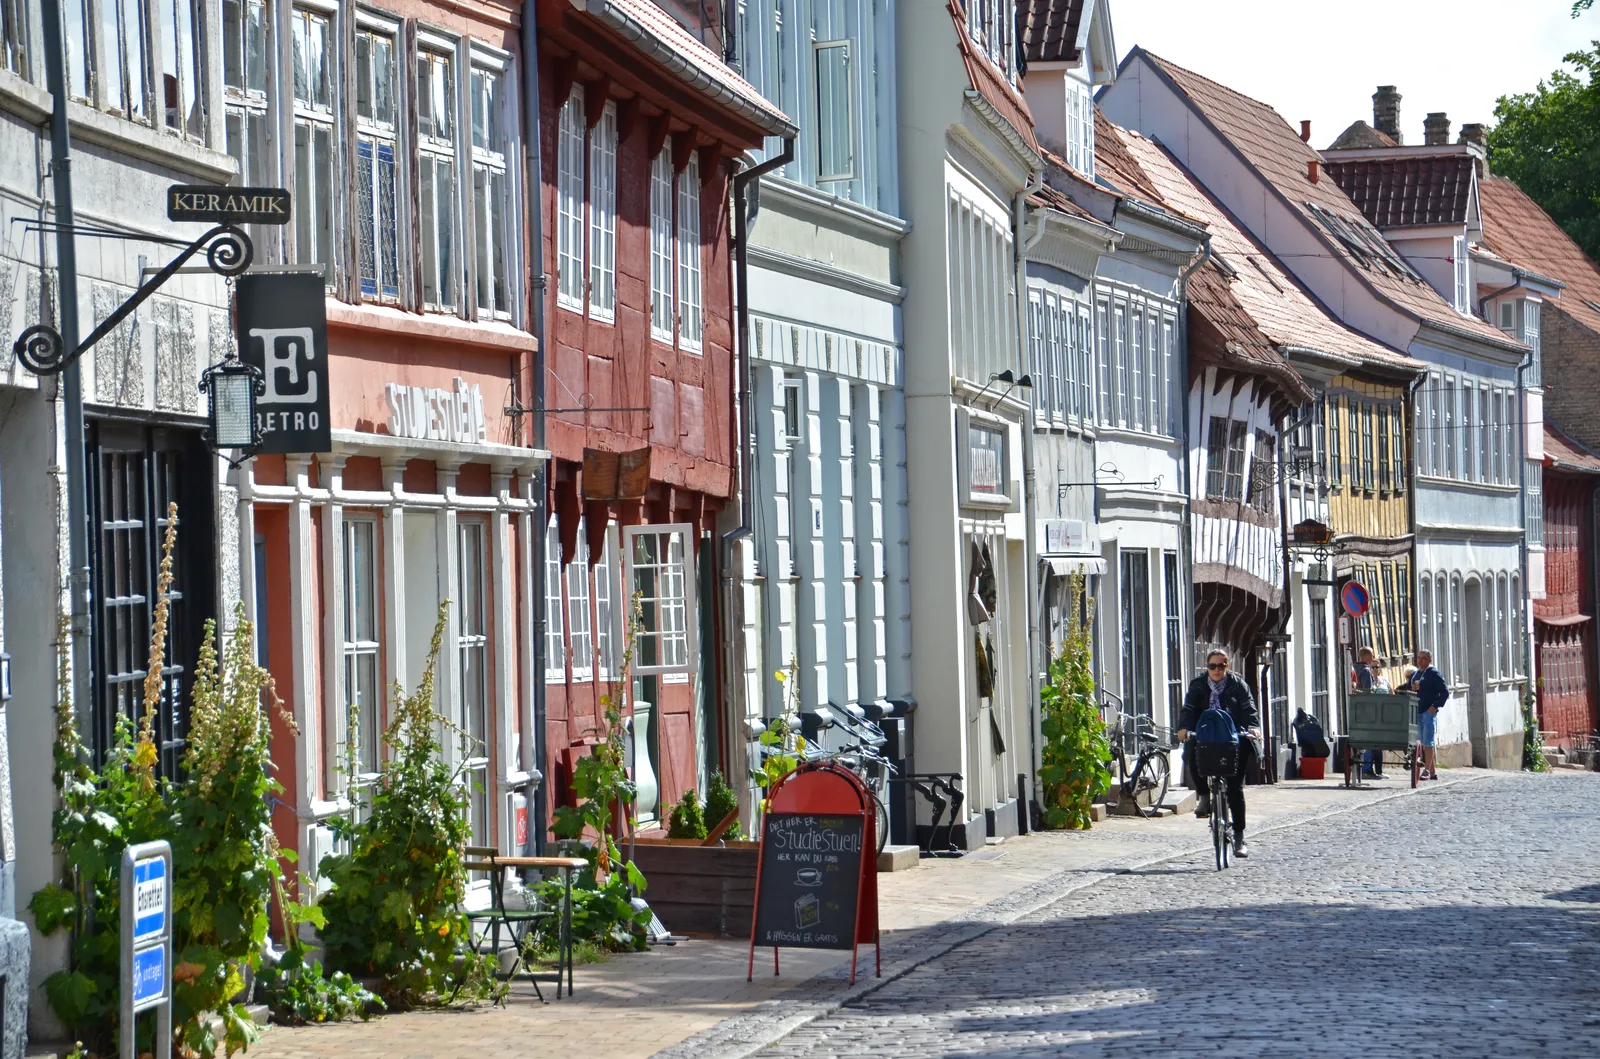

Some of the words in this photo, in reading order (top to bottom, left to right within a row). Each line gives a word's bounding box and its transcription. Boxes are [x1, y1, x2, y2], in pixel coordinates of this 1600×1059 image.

[173, 193, 286, 214] KERAMIK
[769, 819, 783, 832] DET
[785, 817, 802, 827] HER
[804, 817, 817, 827] ER
[777, 853, 790, 861] HER
[794, 852, 811, 862] KAN
[813, 853, 822, 863] DU
[138, 881, 163, 912] Ensrettet
[772, 930, 801, 943] HYGGEN
[803, 932, 813, 943] ER
[814, 934, 838, 943] GRATIS
